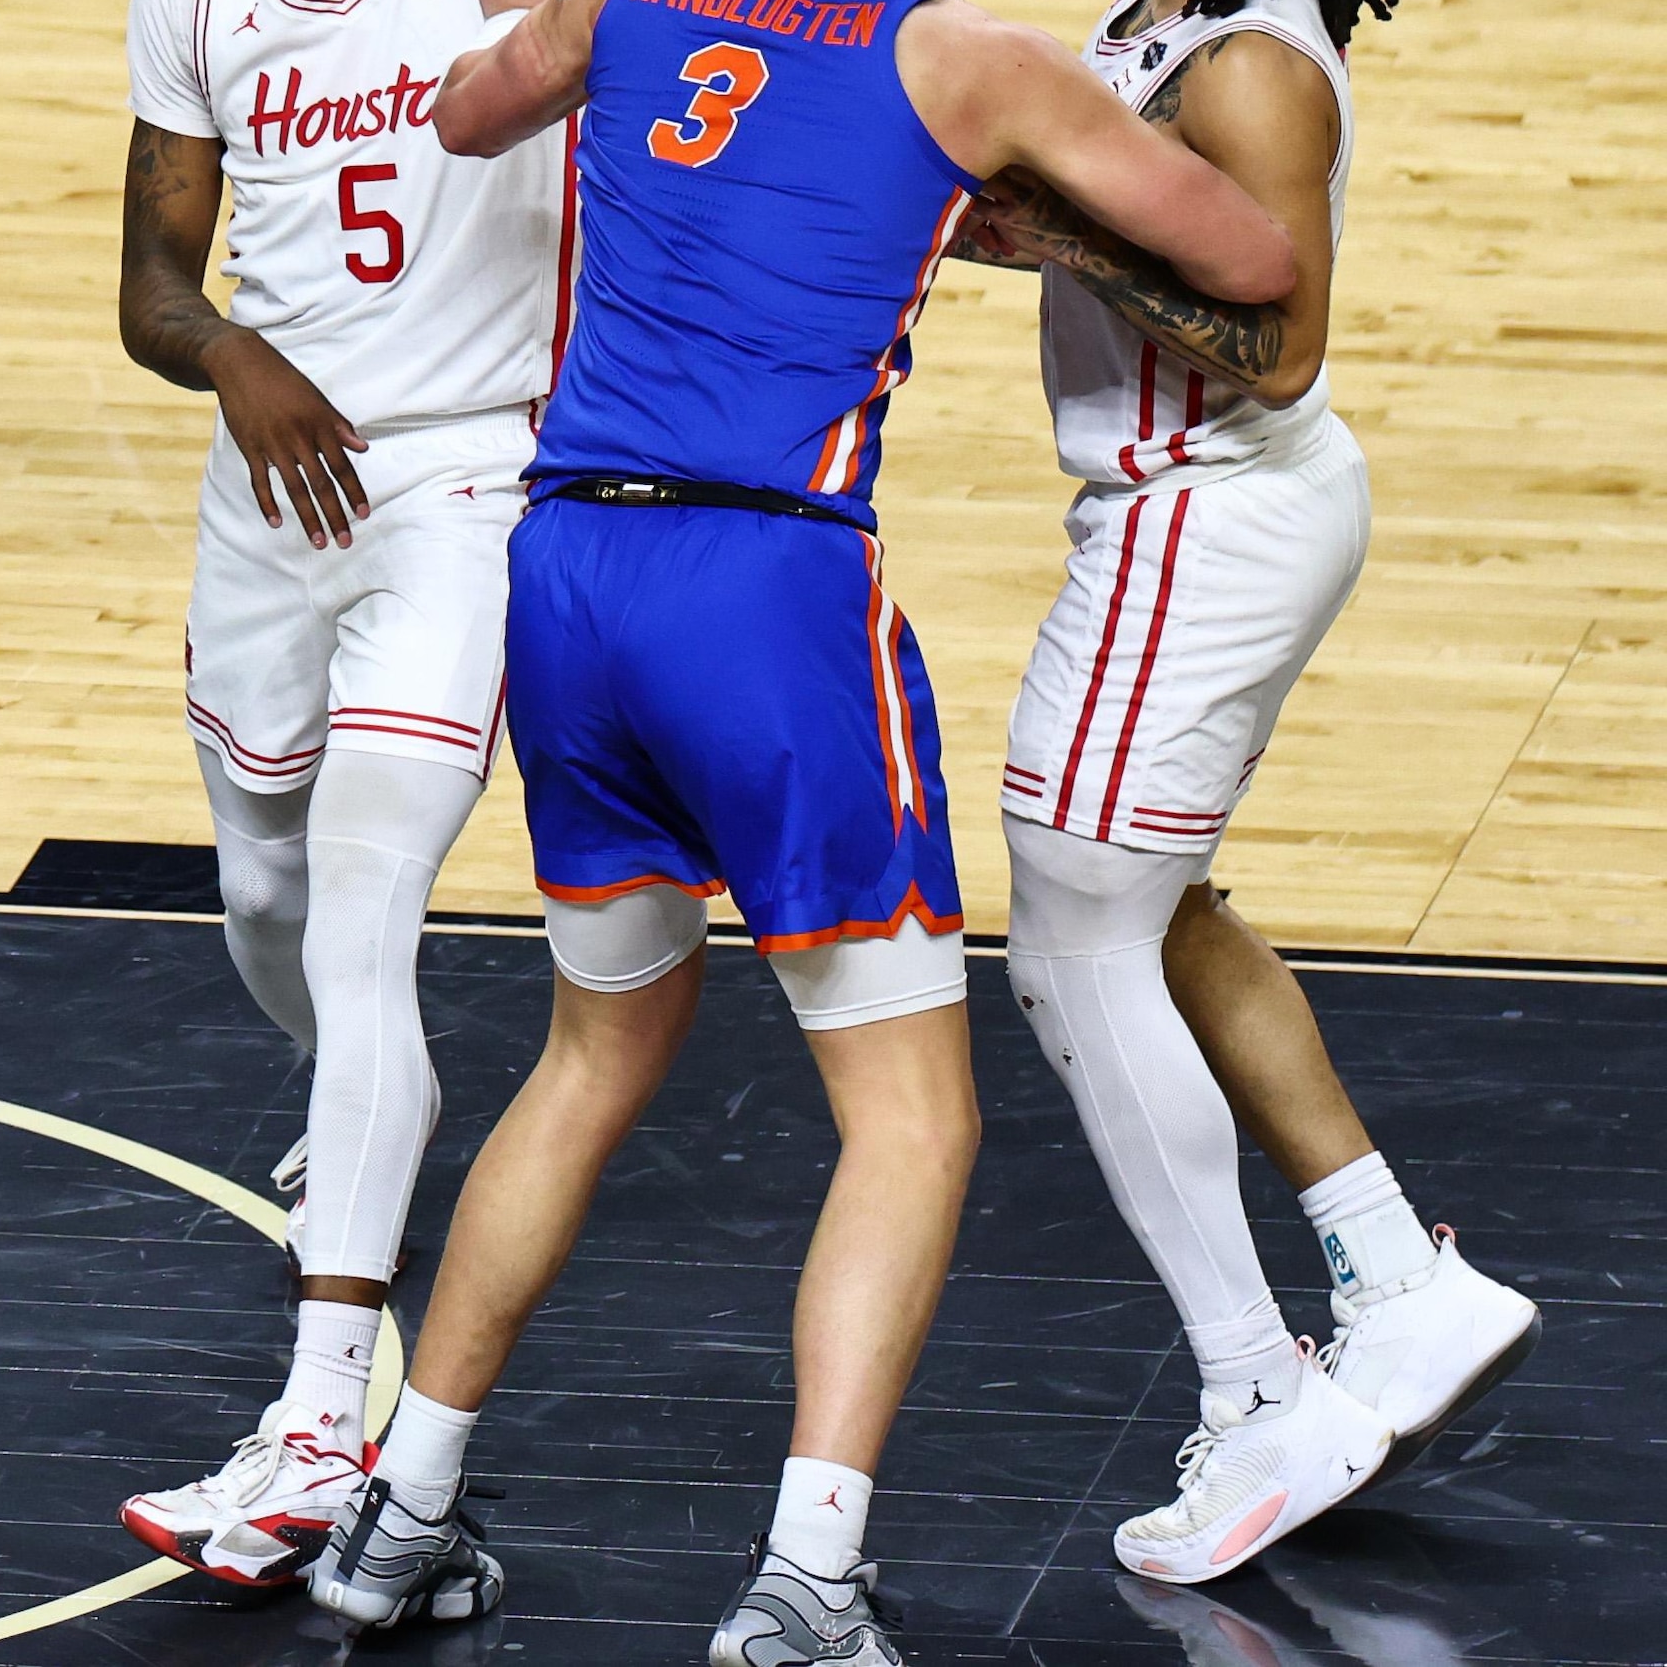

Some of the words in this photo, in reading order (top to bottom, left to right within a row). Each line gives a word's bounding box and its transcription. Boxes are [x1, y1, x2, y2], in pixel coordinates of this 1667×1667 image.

[247, 62, 441, 158] Housto
[647, 40, 770, 169] 3
[338, 162, 405, 284] 5
